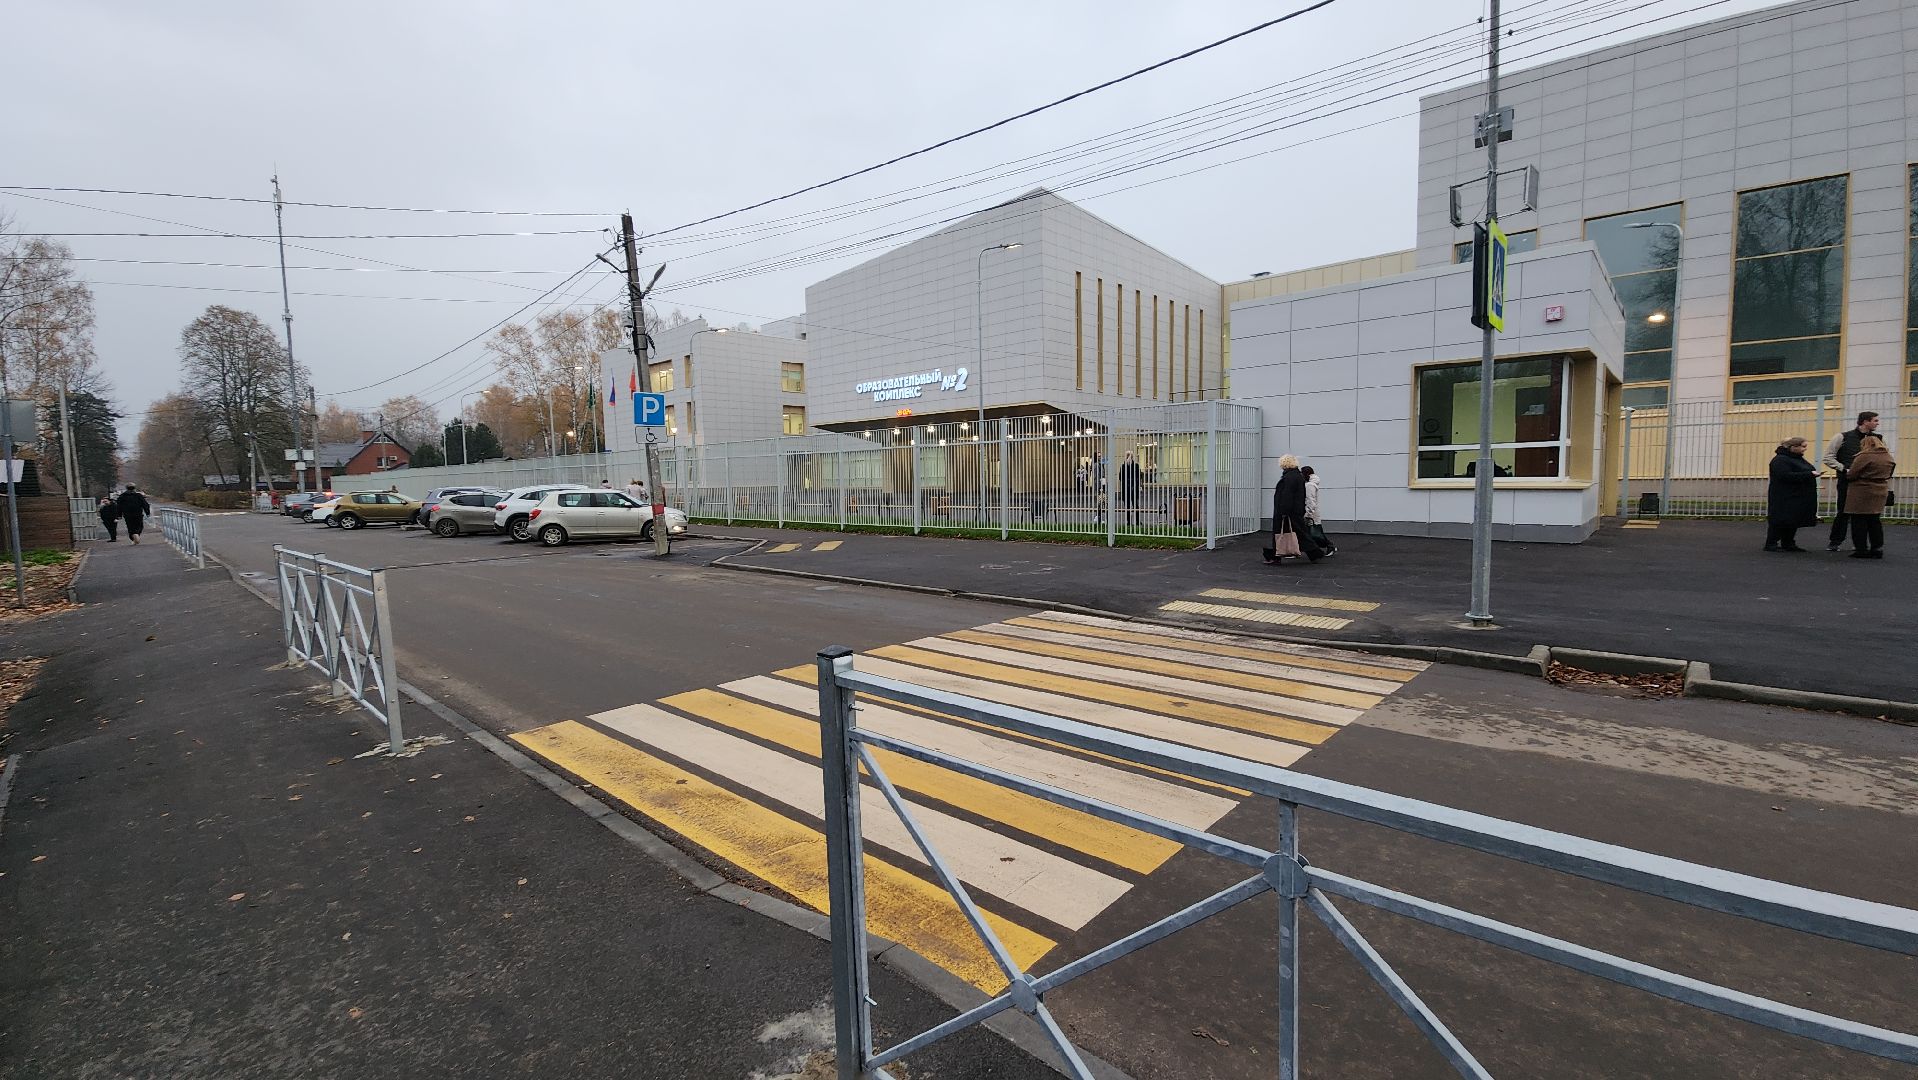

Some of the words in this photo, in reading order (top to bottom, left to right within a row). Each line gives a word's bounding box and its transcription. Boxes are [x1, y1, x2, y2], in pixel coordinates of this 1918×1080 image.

[856, 368, 942, 394] ОБРАЗОВАТЕЛЬНЫЙ
[874, 386, 922, 402] КОМПЛЕКС
[643, 396, 660, 423] P
